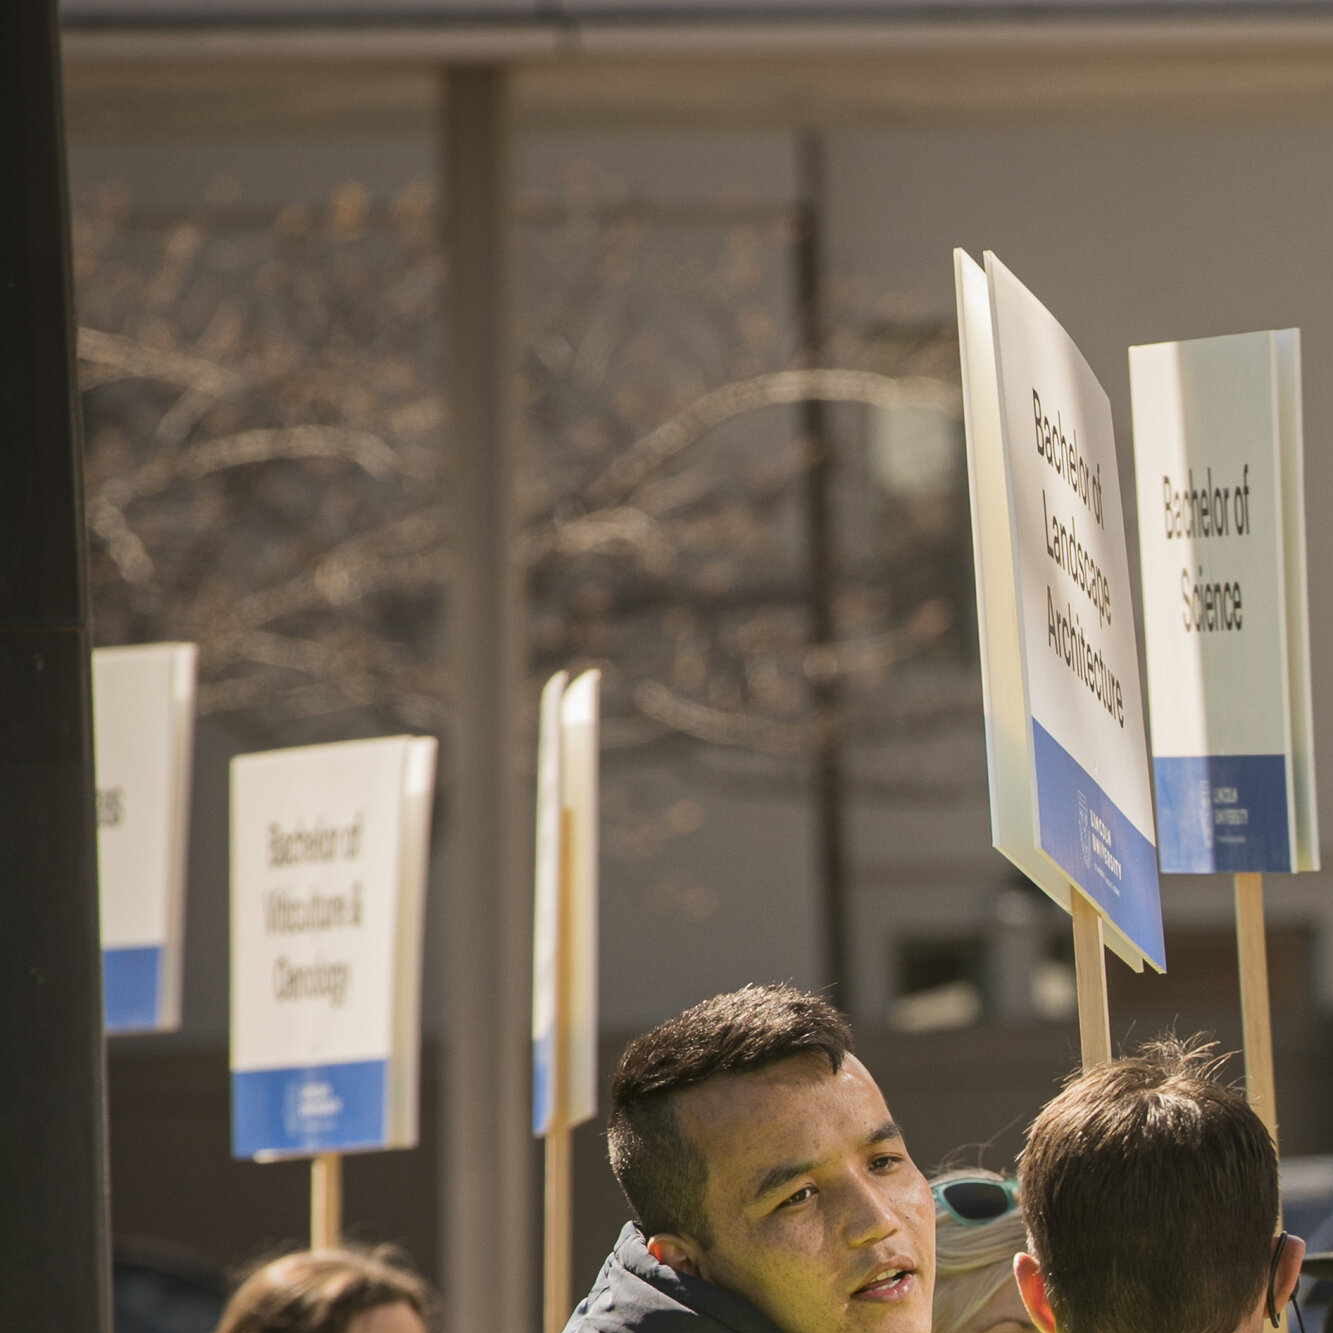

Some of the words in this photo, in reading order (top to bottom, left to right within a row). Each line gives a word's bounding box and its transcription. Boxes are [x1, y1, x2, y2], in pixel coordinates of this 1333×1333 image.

[1032, 387, 1090, 512] Bachelor
[1092, 463, 1104, 531] of
[1163, 467, 1229, 540] Bachelor
[1234, 463, 1250, 537] of
[1042, 488, 1112, 629] Landscape
[1181, 564, 1243, 633] Science
[1047, 584, 1124, 729] Architecture
